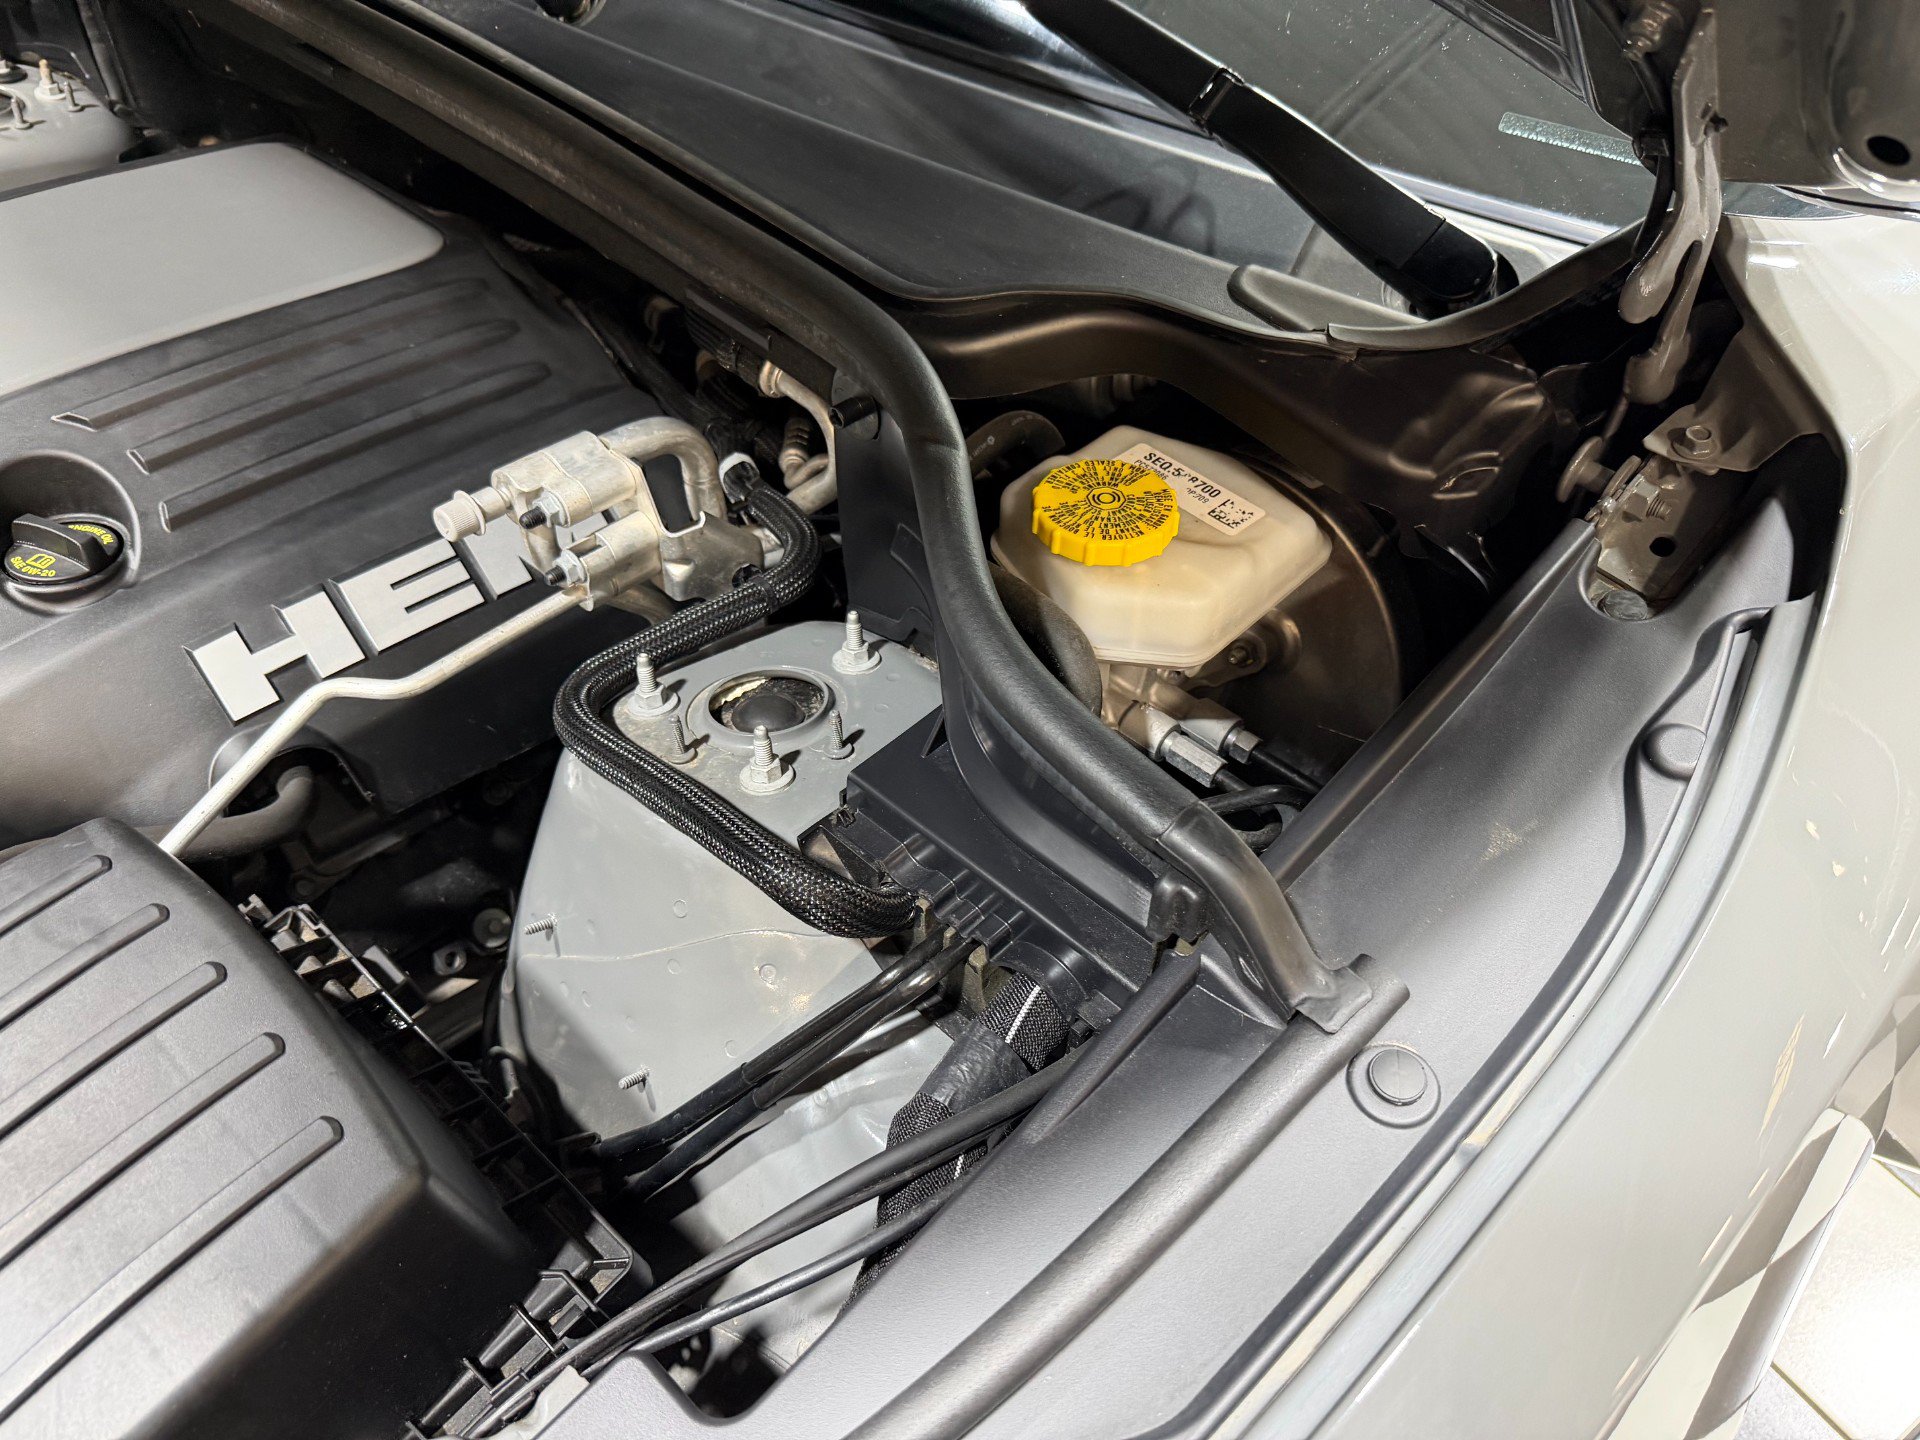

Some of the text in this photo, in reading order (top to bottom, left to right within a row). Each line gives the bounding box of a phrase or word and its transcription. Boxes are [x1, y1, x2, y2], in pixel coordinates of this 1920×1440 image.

[1128, 464, 1150, 476] FROM
[1161, 487, 1172, 501] MISE
[1048, 514, 1080, 534] BOUCHON
[1114, 524, 1141, 534] AVANT
[101, 534, 114, 545] OIL
[1100, 529, 1146, 540] NETTOYER
[10, 556, 56, 578] SAE 0W-20
